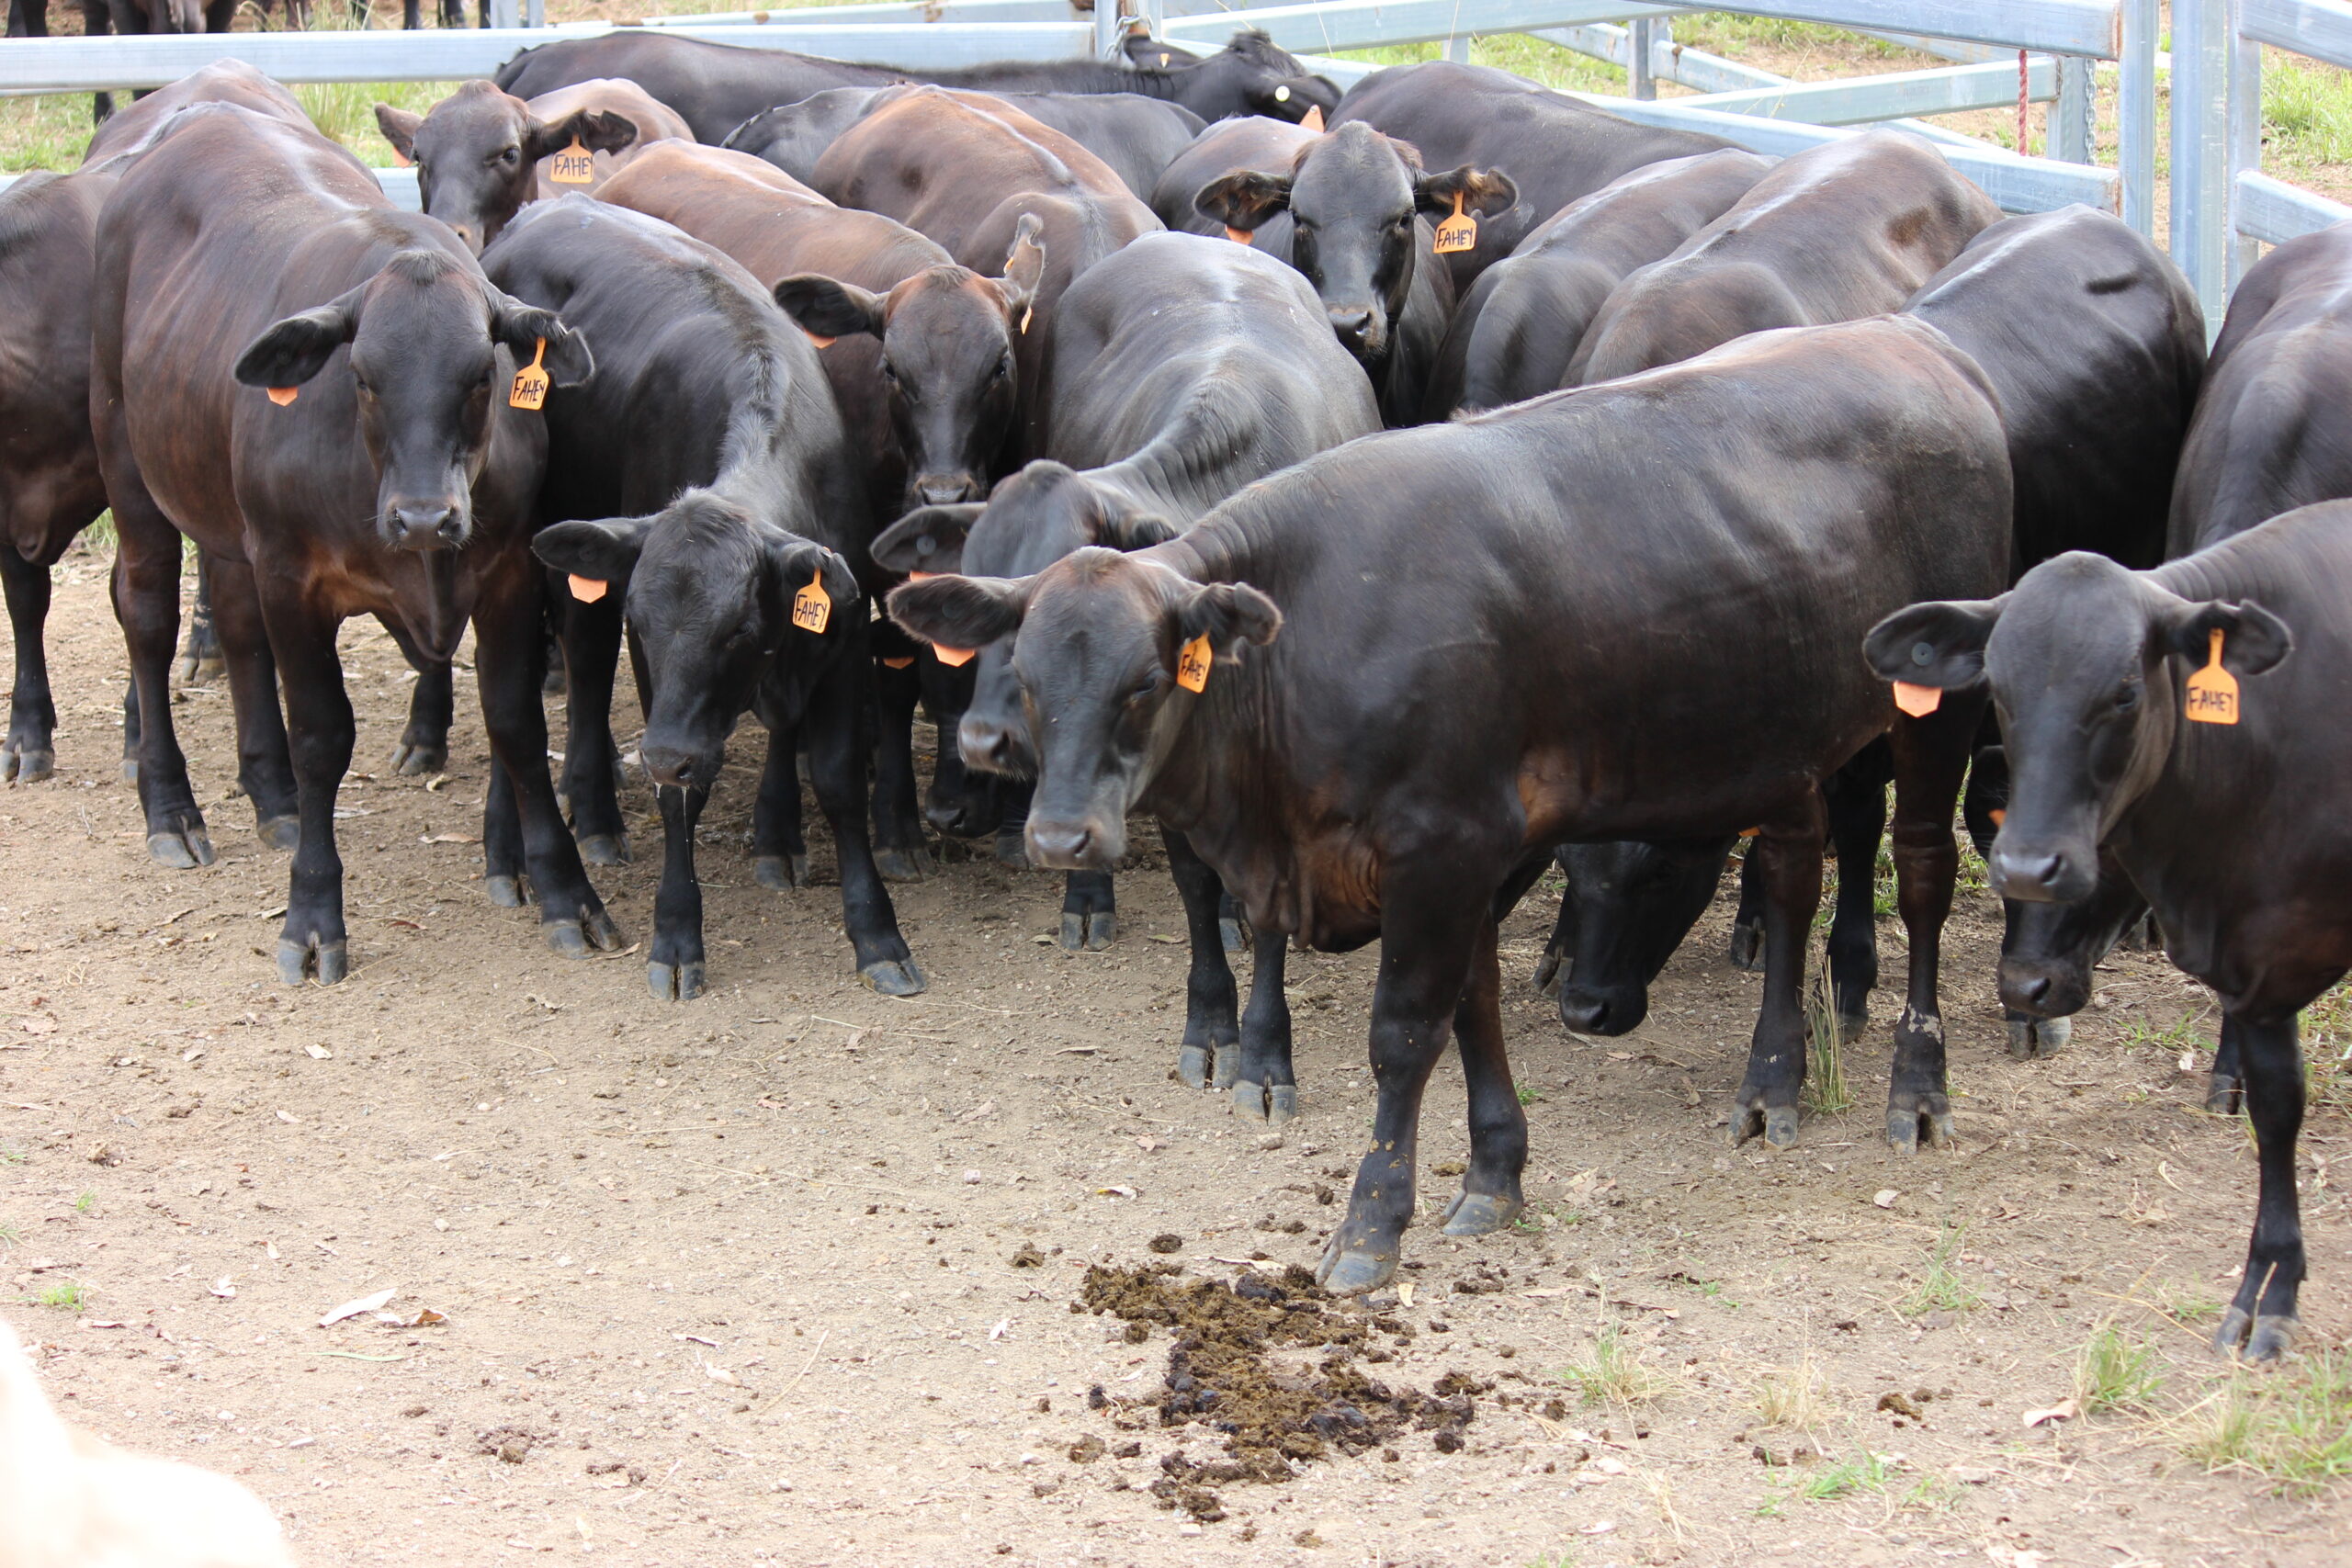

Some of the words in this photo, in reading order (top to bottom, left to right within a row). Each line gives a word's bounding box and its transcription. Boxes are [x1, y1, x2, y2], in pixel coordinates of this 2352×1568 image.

[554, 153, 593, 177] FAHEY
[1437, 227, 1473, 249] FAHEY
[513, 377, 545, 402] FAHEY
[795, 594, 827, 629] FAHEY
[2189, 686, 2233, 717] FAHEY
